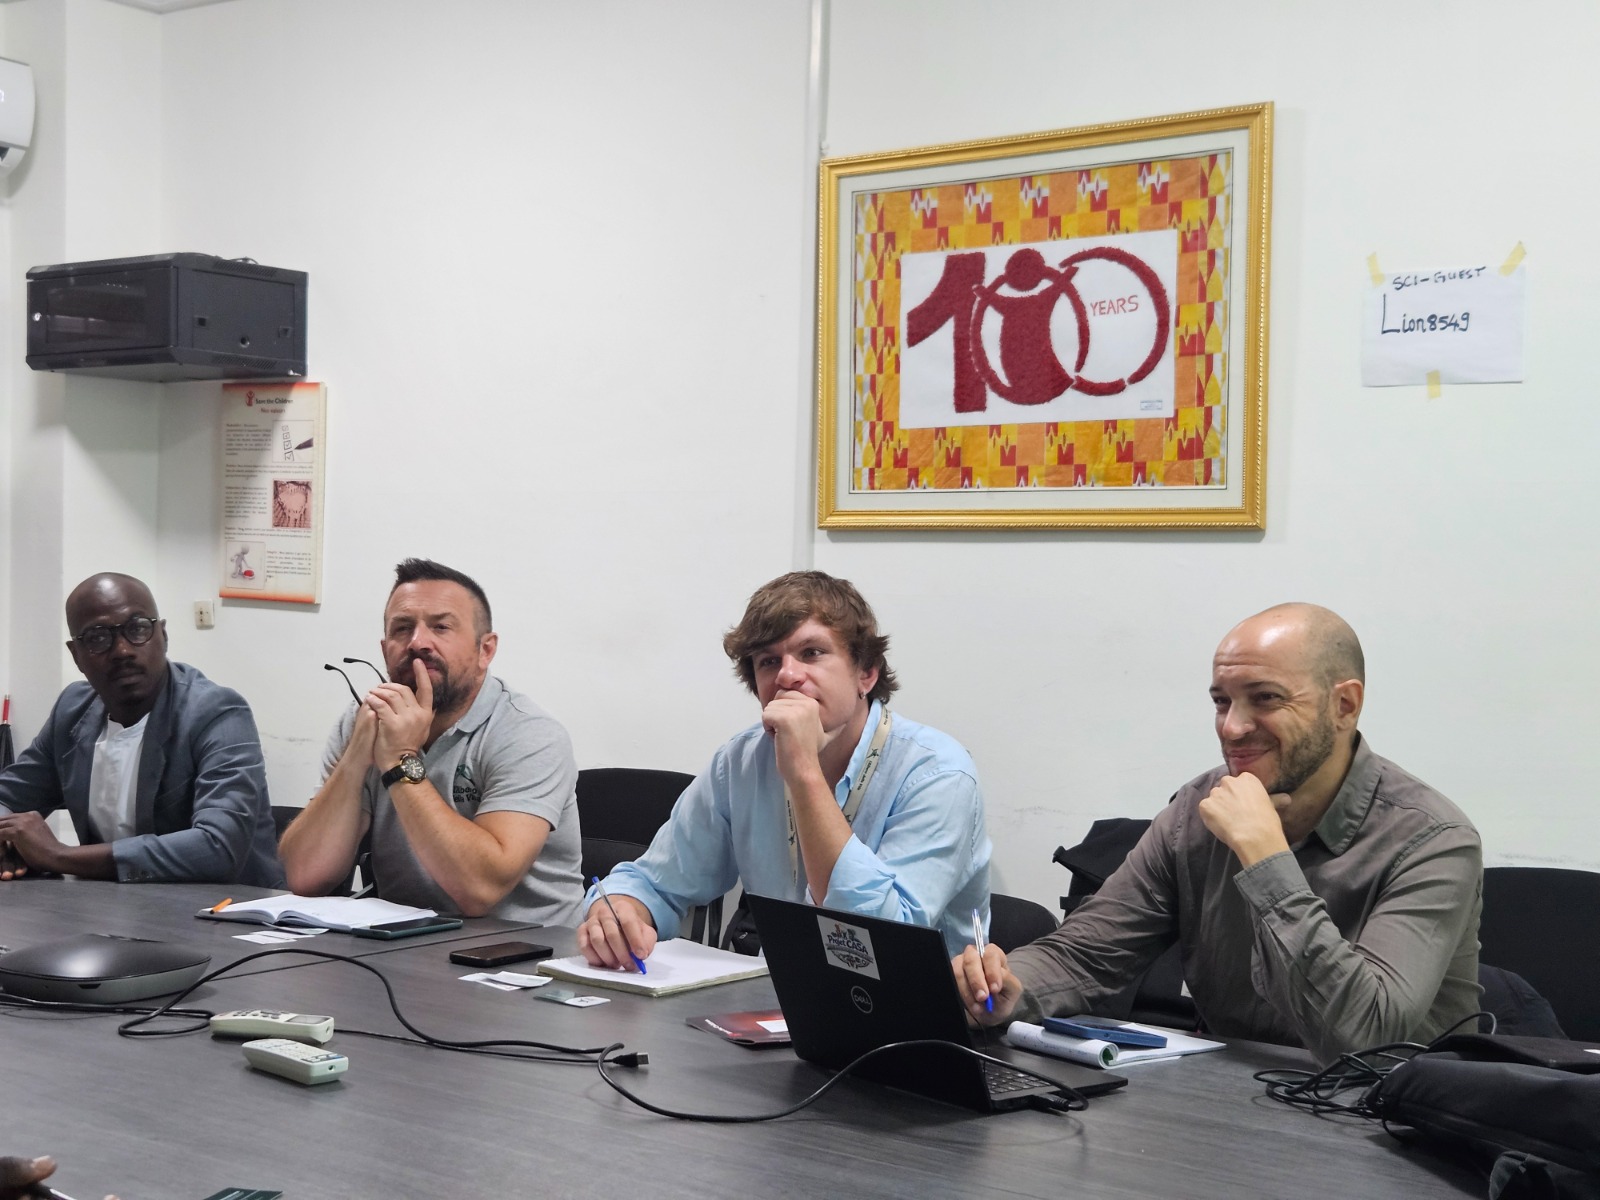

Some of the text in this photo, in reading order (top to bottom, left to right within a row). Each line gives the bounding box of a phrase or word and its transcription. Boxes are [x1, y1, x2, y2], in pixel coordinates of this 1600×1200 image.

[1392, 266, 1487, 291] SCI-GUEST
[1090, 295, 1139, 317] YEARS
[1381, 293, 1470, 335] Lion8549
[827, 934, 868, 954] Projet CASA
[854, 995, 870, 1004] DELL
